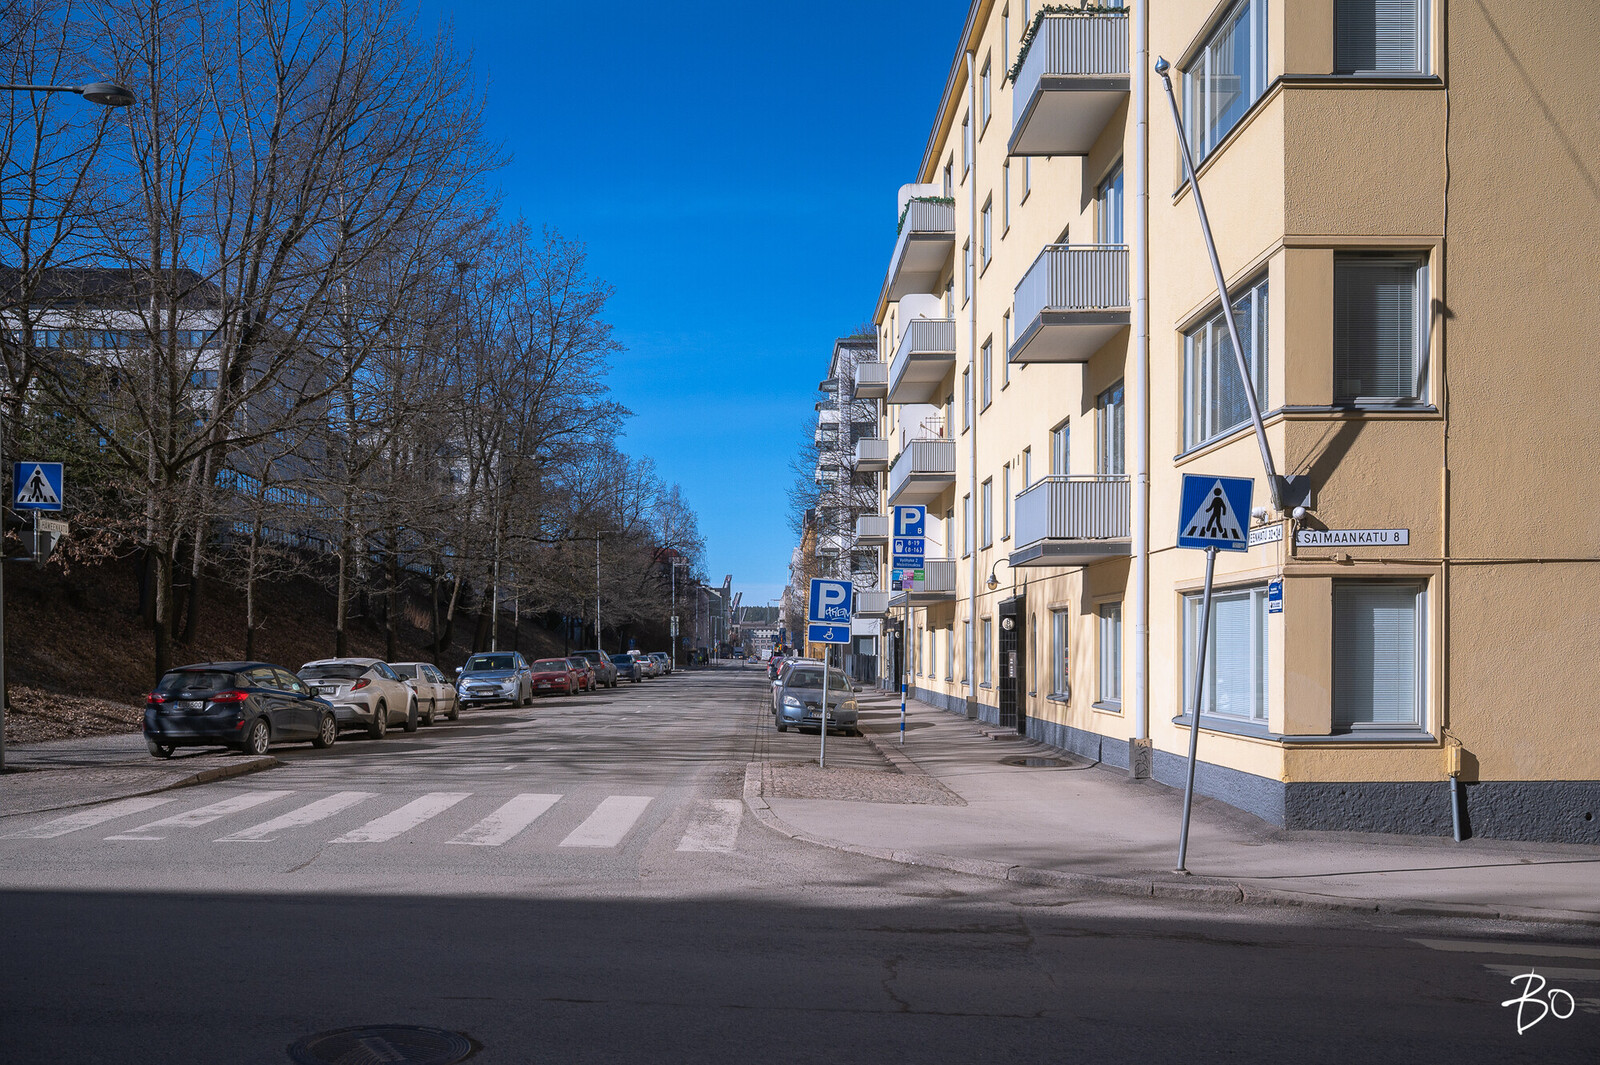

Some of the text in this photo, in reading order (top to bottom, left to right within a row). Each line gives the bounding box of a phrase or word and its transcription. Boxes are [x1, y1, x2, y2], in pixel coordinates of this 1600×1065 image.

[900, 508, 921, 535] P
[1304, 532, 1400, 543] SAIMAANKATU 8
[817, 582, 846, 619] P
